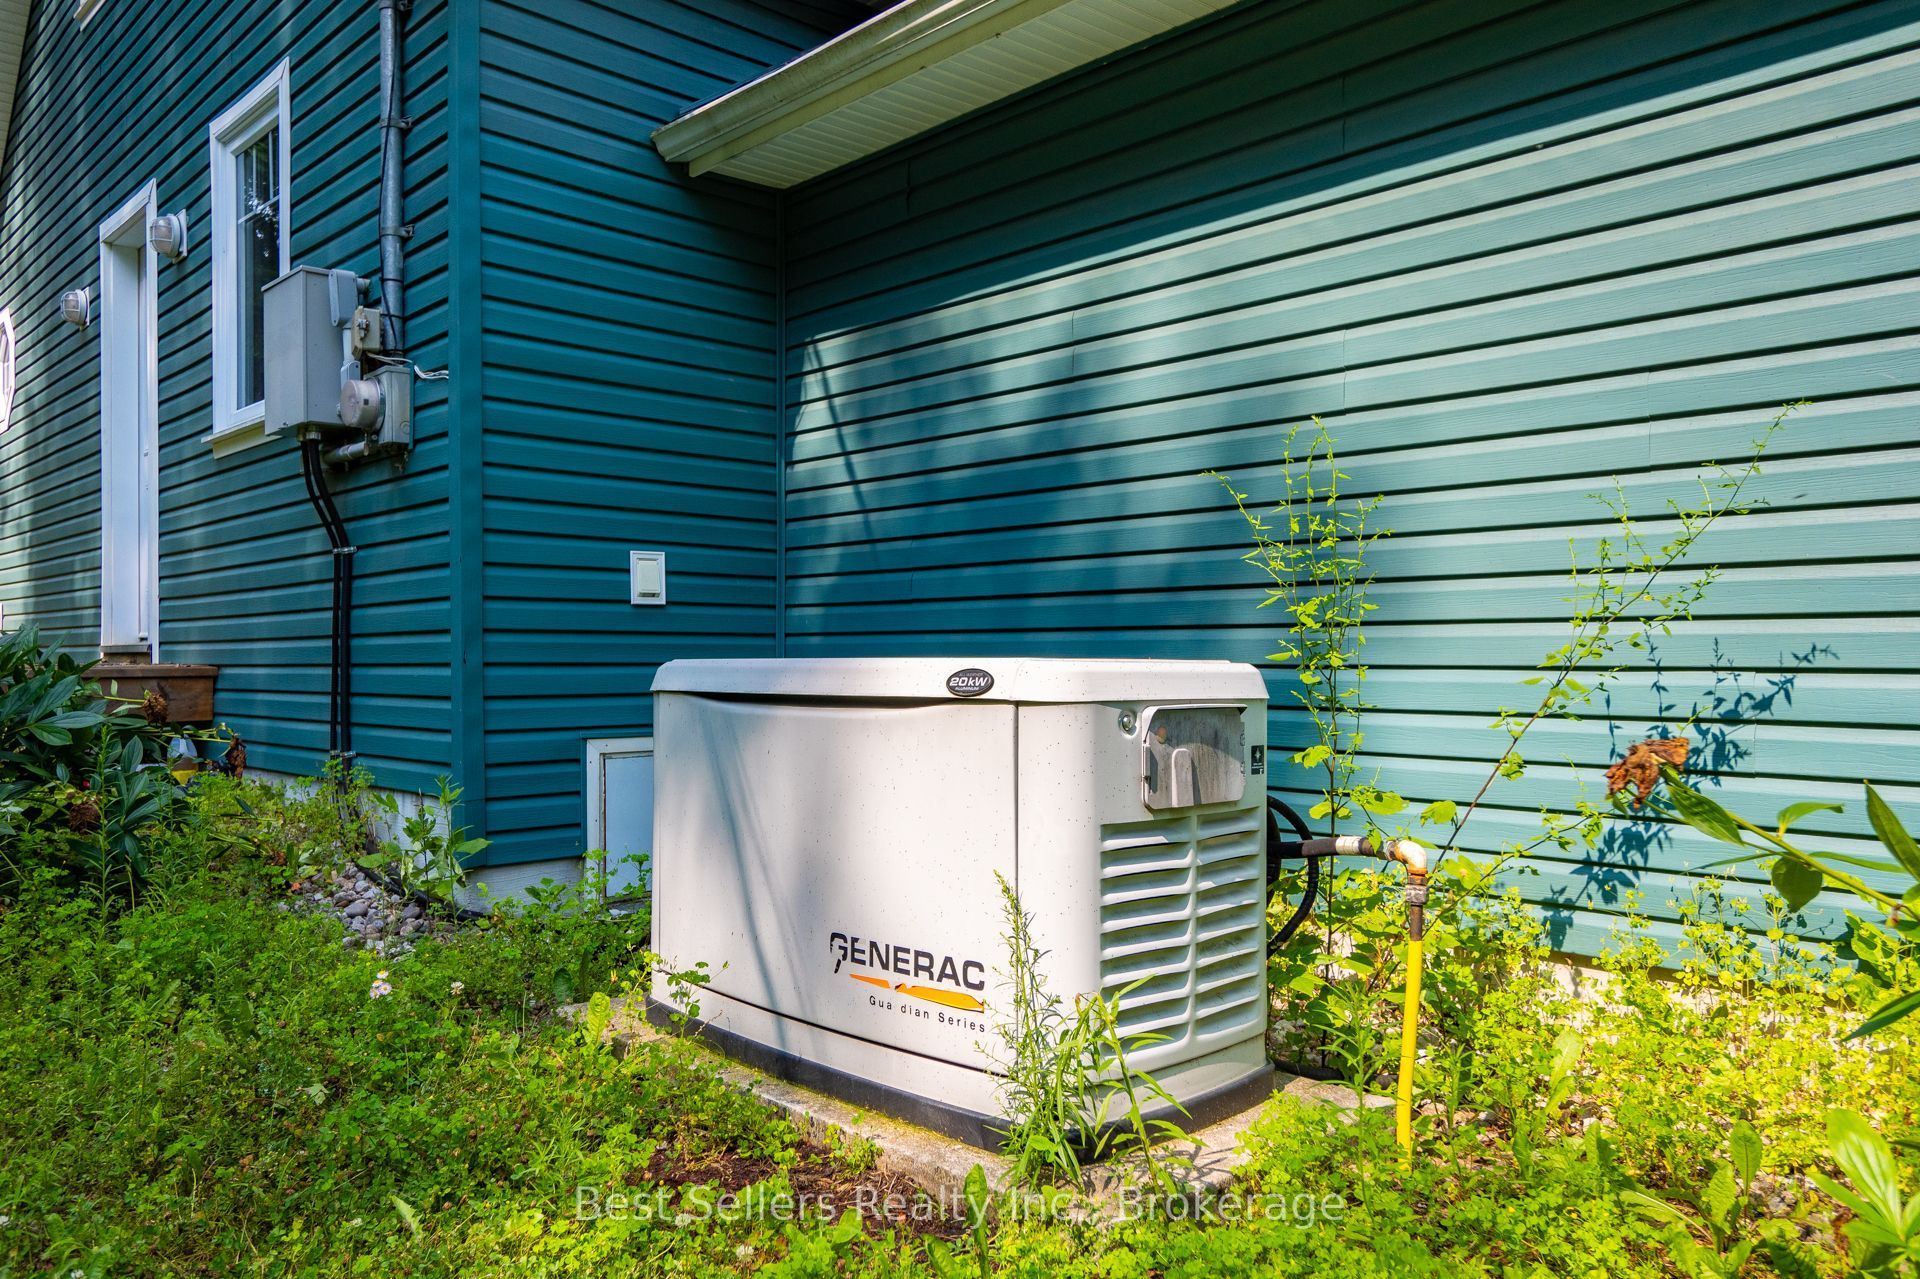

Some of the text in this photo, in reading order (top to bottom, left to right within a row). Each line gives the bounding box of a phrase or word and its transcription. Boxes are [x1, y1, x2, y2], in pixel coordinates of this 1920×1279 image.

[949, 676, 988, 687] 20kW
[830, 932, 985, 991] GENERAC
[938, 1012, 985, 1032] Series
